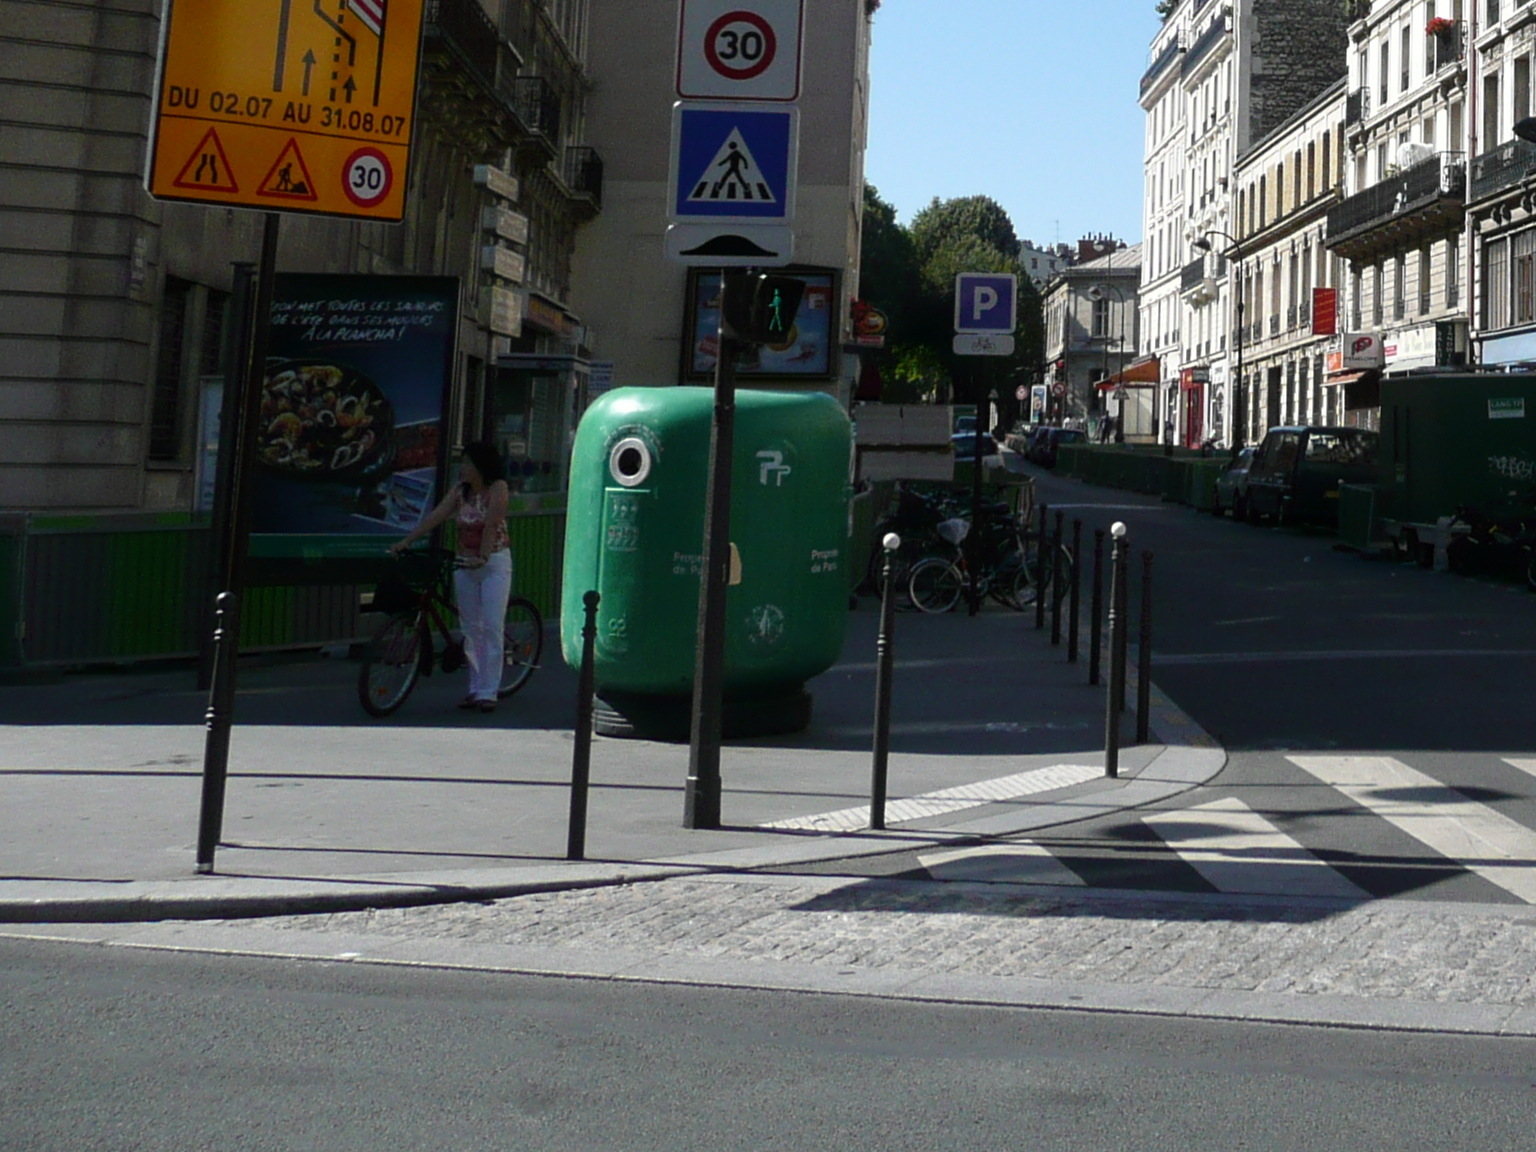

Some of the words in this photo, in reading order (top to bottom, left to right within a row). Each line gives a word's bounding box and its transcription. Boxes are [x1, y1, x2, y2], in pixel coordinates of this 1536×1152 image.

[718, 31, 763, 61] 30
[168, 86, 200, 109] DU
[209, 91, 273, 119] 02.07
[283, 100, 311, 125] AU
[321, 105, 406, 137] 31.08.07
[352, 165, 381, 190] 30
[972, 285, 998, 321] P
